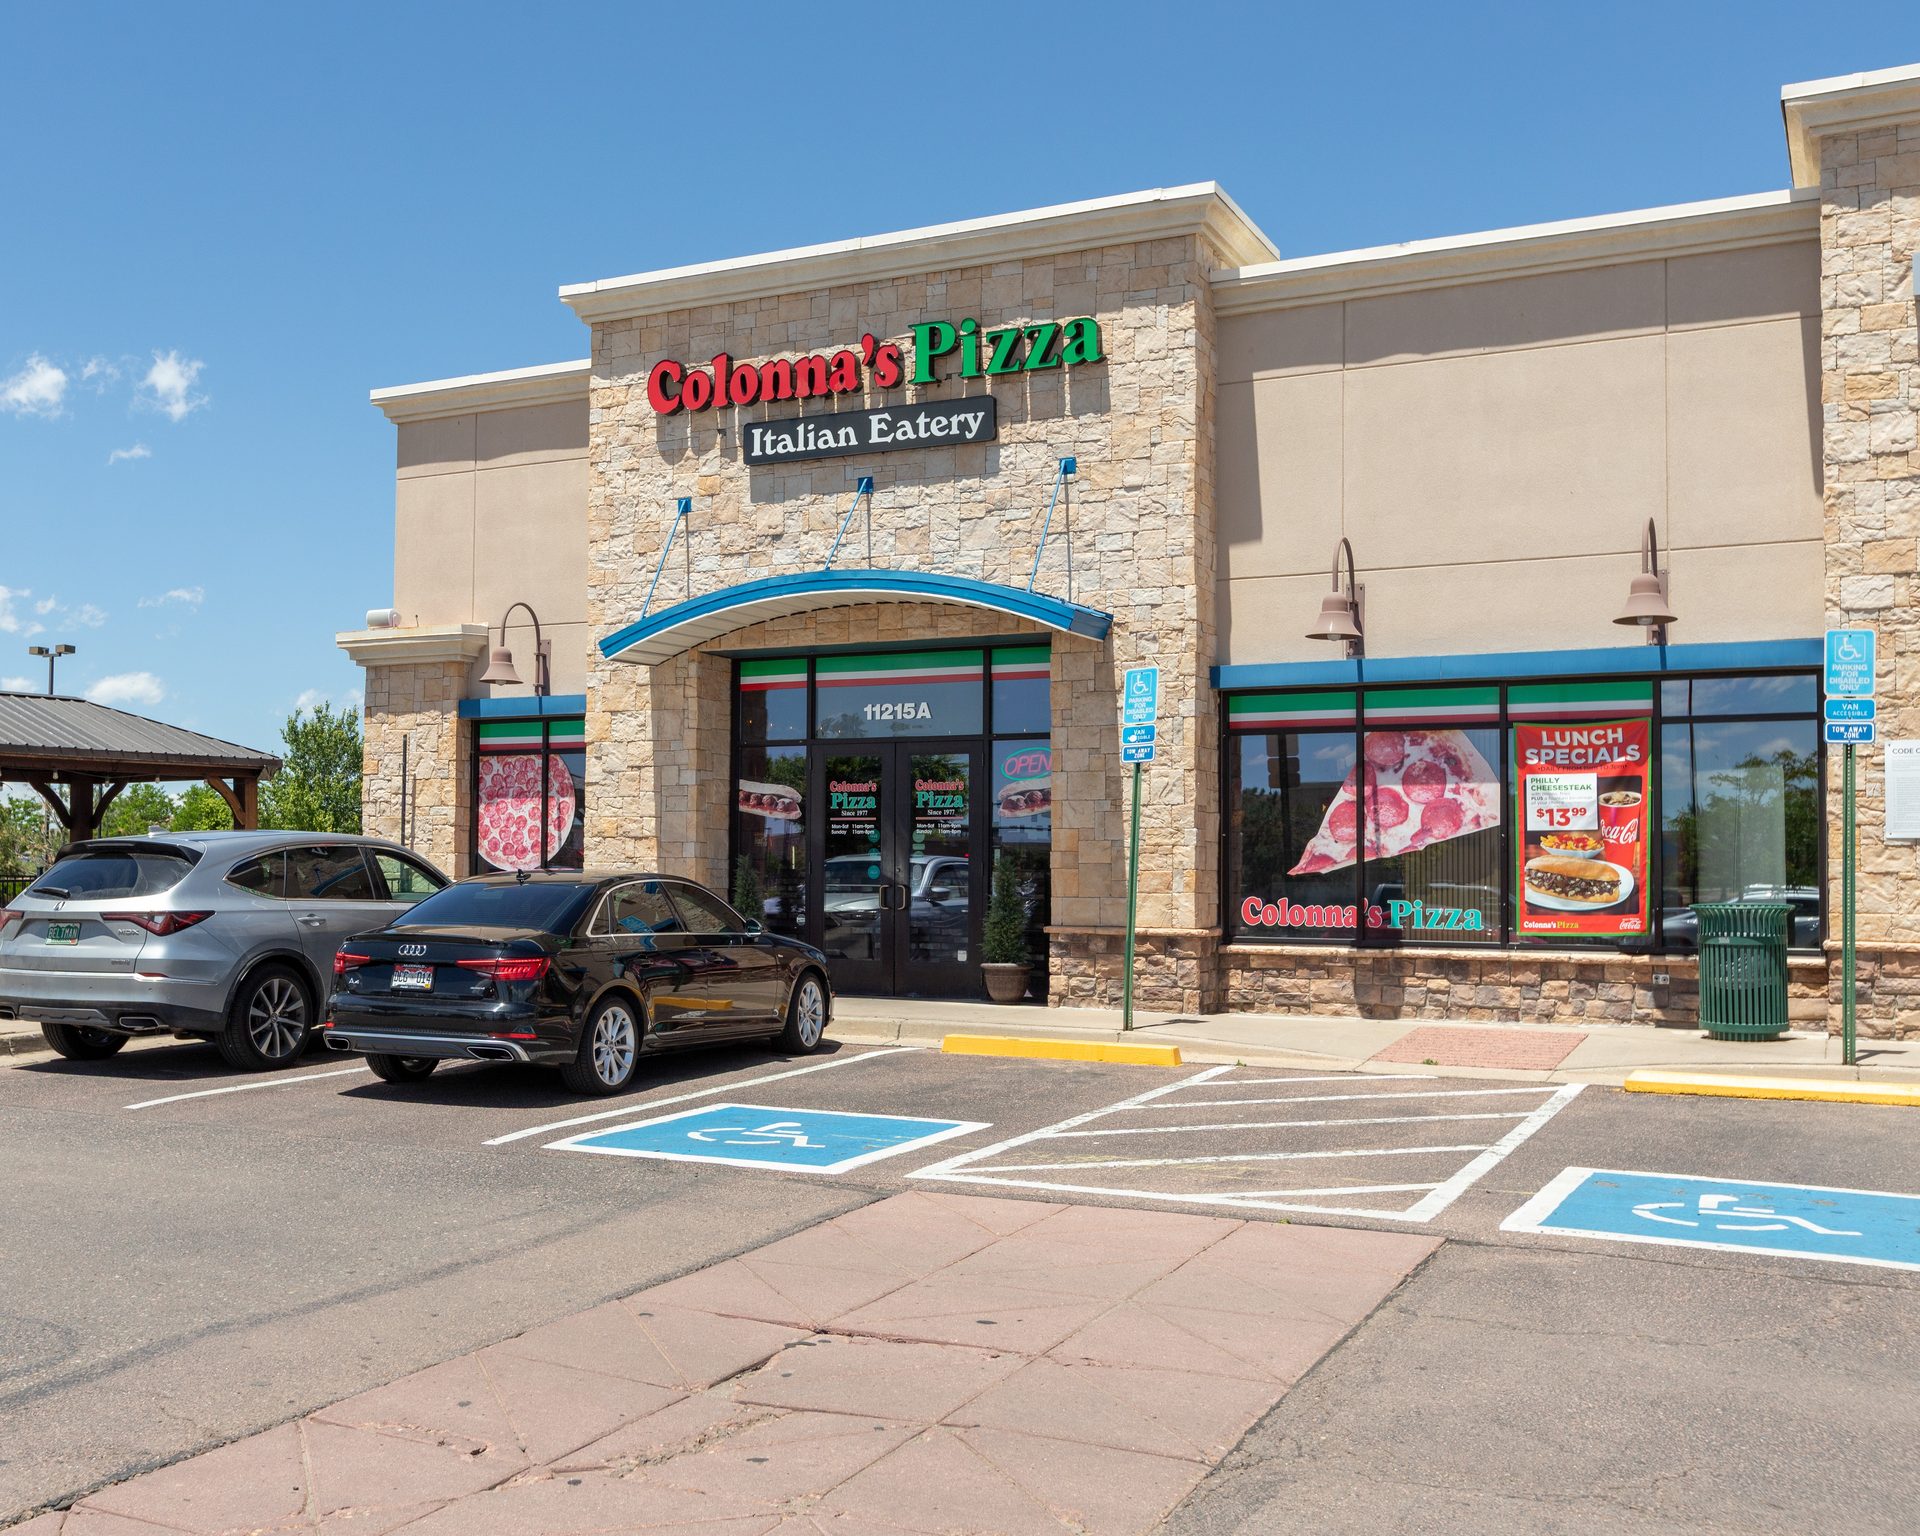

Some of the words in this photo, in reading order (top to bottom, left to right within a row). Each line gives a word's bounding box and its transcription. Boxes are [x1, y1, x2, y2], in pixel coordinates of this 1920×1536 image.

[647, 332, 903, 416] Colonna's
[909, 317, 1106, 385] Pizza
[751, 424, 858, 457] Italian
[868, 407, 985, 442] Eatery
[1832, 663, 1868, 671] PARKING
[1829, 677, 1870, 685] DISABLED
[1129, 696, 1153, 704] PARKING
[863, 702, 932, 721] 11215A
[1126, 707, 1154, 715] DISABLED
[1842, 703, 1859, 711] VAN
[1541, 727, 1624, 747] LUNCH
[1525, 744, 1641, 765] SPECIALS
[1892, 747, 1914, 755] CODE
[1004, 752, 1053, 776] OPEN
[830, 780, 877, 793] Colonna's
[915, 779, 964, 791] Colonna's
[830, 792, 877, 810] Pizza
[916, 791, 964, 808] Pizza
[1241, 896, 1383, 929] Colonna's
[1387, 899, 1485, 931] Pizza
[1523, 920, 1557, 929] Colonna's
[1557, 920, 1579, 929] Pizza
[48, 925, 78, 939] BELTMAN
[118, 928, 140, 936] MDX
[349, 977, 360, 985] A4
